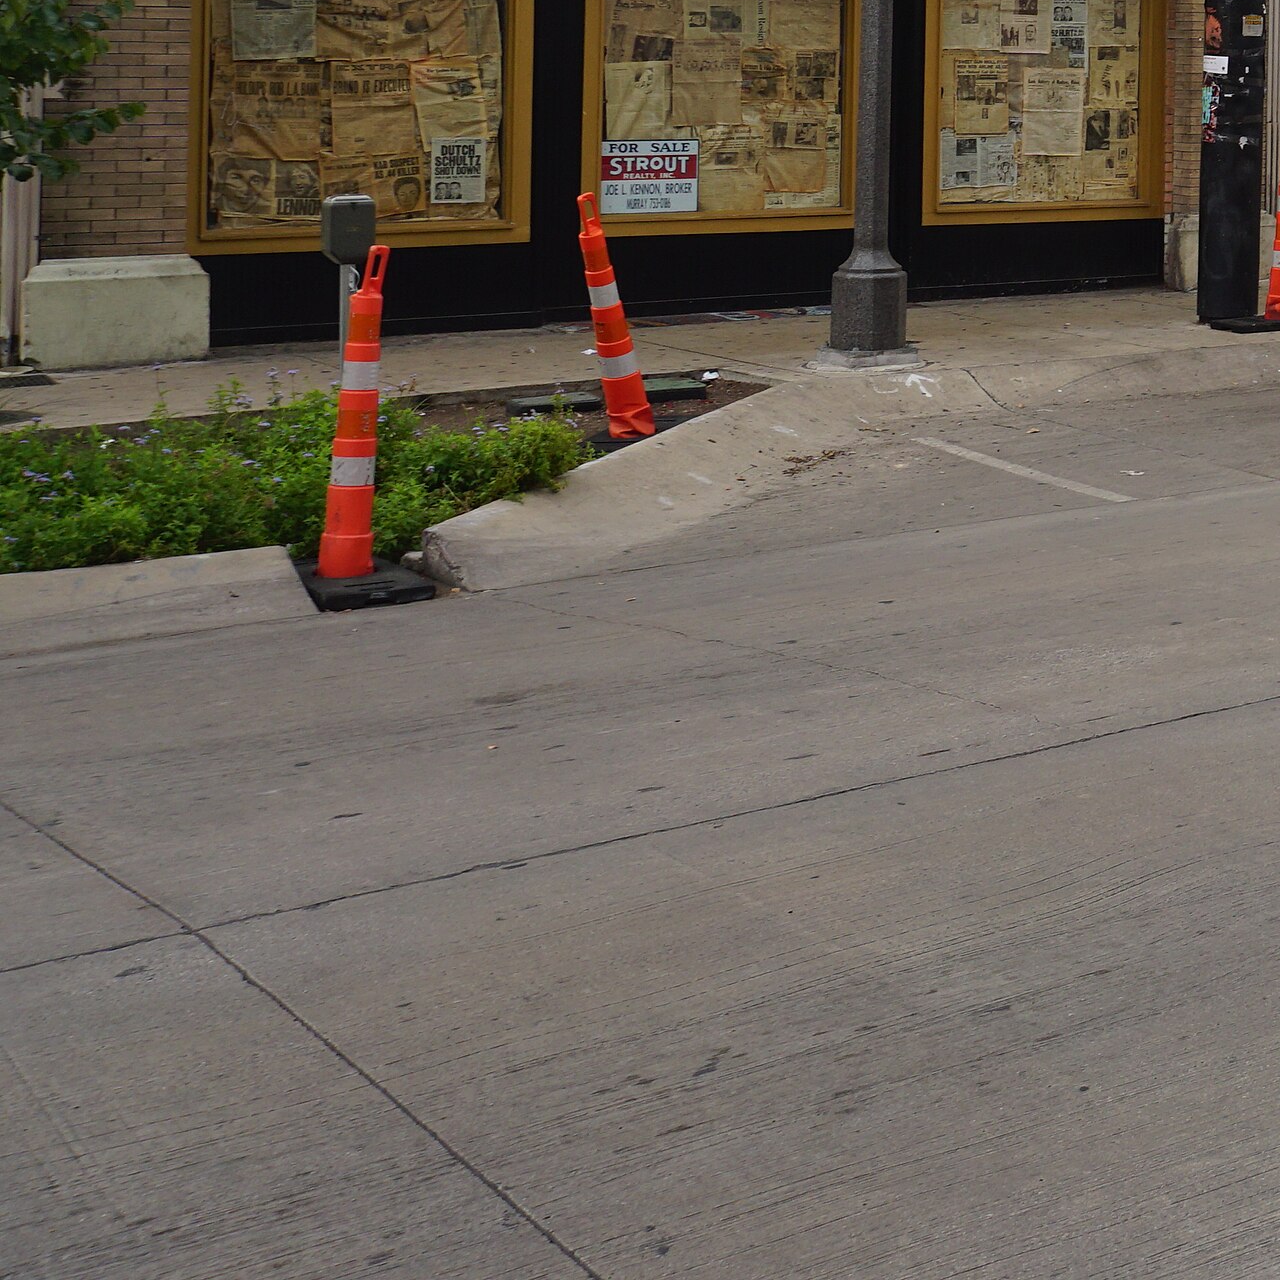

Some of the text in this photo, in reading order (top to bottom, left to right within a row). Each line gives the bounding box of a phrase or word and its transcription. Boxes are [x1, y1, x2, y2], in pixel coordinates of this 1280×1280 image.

[441, 145, 475, 156] DUTCH
[609, 143, 690, 153] FOR SALE
[390, 156, 420, 168] SUSPECT
[434, 156, 481, 167] SCHULTZ
[609, 156, 690, 175] STROUT
[434, 166, 454, 176] SHOT
[605, 184, 619, 196] JOE
[630, 184, 662, 196] KENNON,
[665, 183, 692, 194] BROKER
[626, 198, 647, 209] MURRAY
